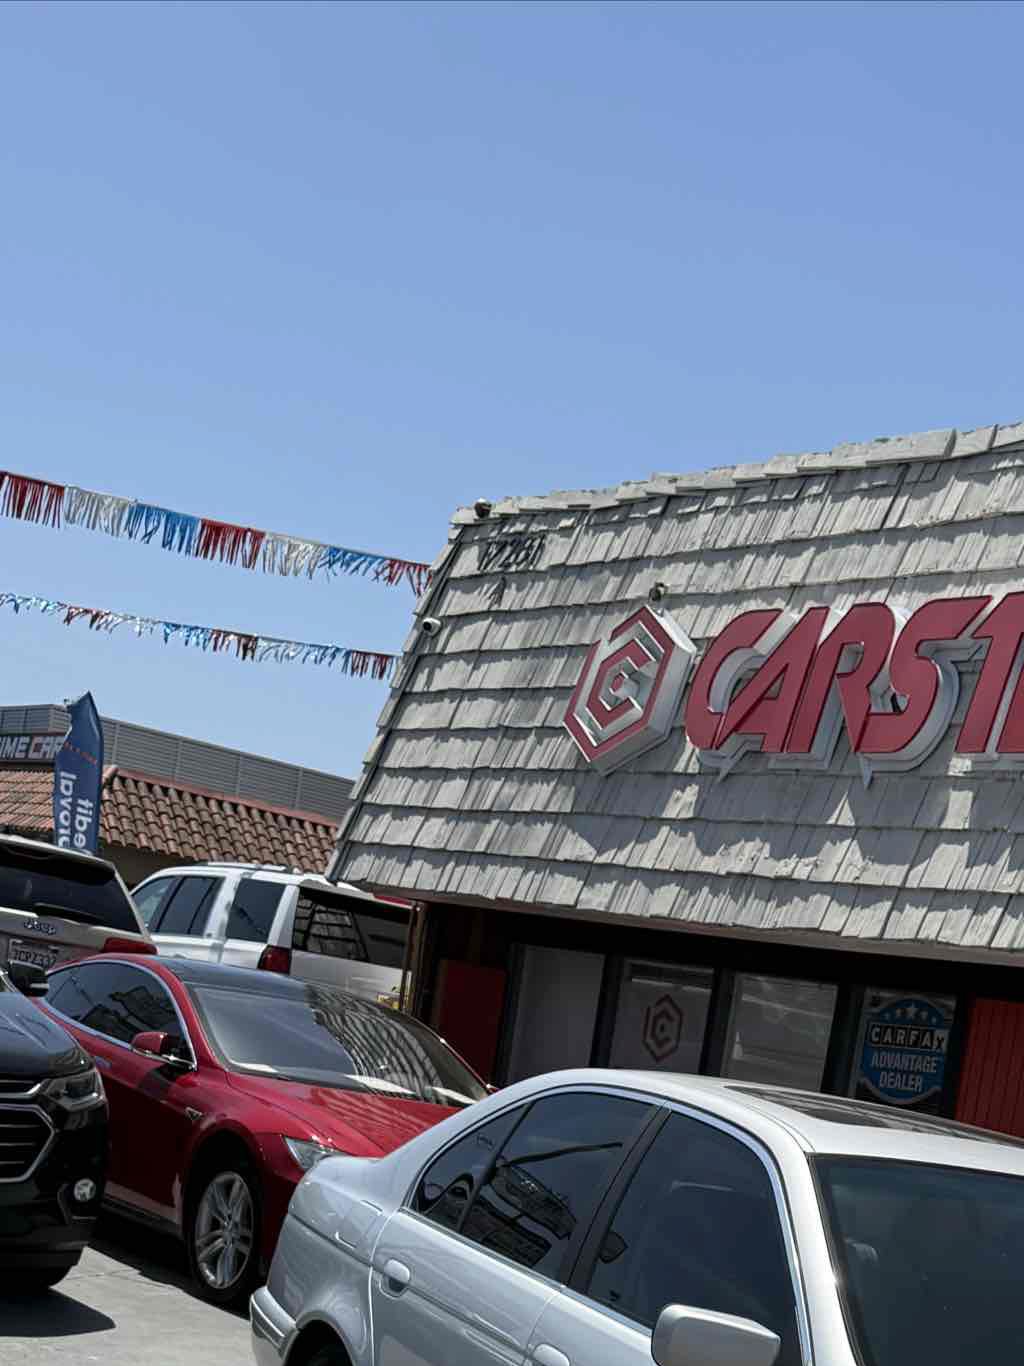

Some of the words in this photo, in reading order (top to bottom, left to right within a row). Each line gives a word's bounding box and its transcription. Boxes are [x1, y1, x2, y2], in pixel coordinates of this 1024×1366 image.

[870, 1025, 950, 1052] CARFAX
[870, 1050, 938, 1073] ADVANTAGE
[879, 1071, 924, 1093] DEALER
